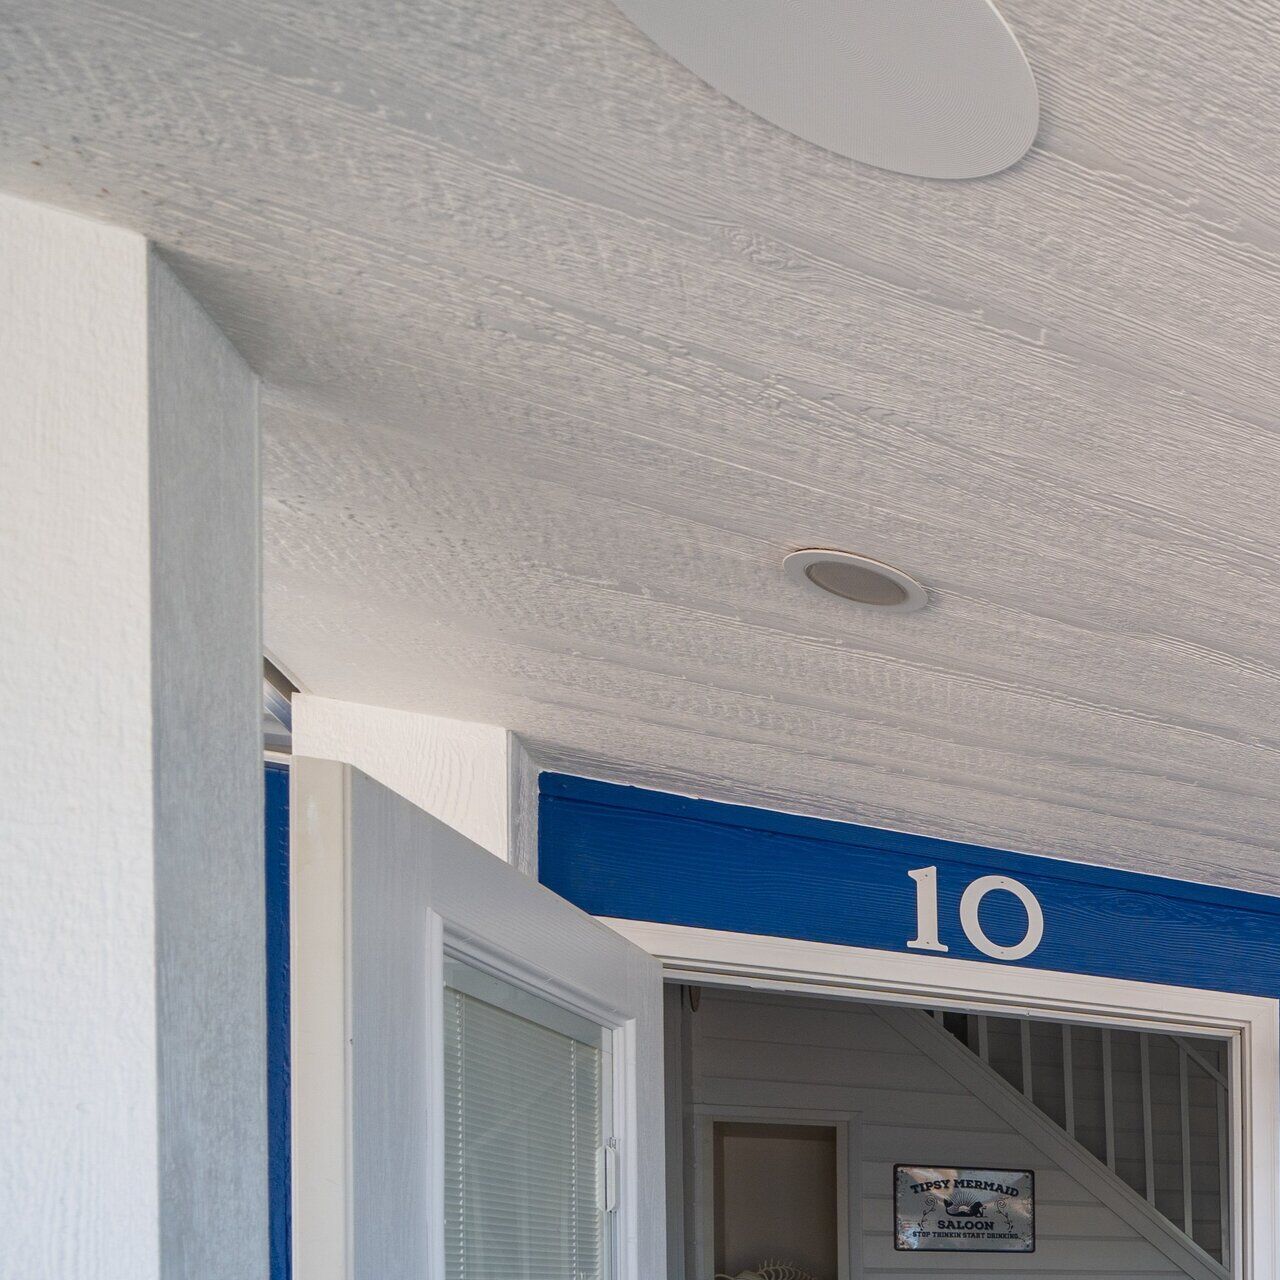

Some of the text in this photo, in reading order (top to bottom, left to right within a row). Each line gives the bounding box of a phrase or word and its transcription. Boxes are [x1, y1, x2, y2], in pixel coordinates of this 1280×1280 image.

[907, 865, 1044, 961] 10
[910, 1179, 1020, 1198] TIPSY MERMAID
[937, 1220, 995, 1231] SALOON
